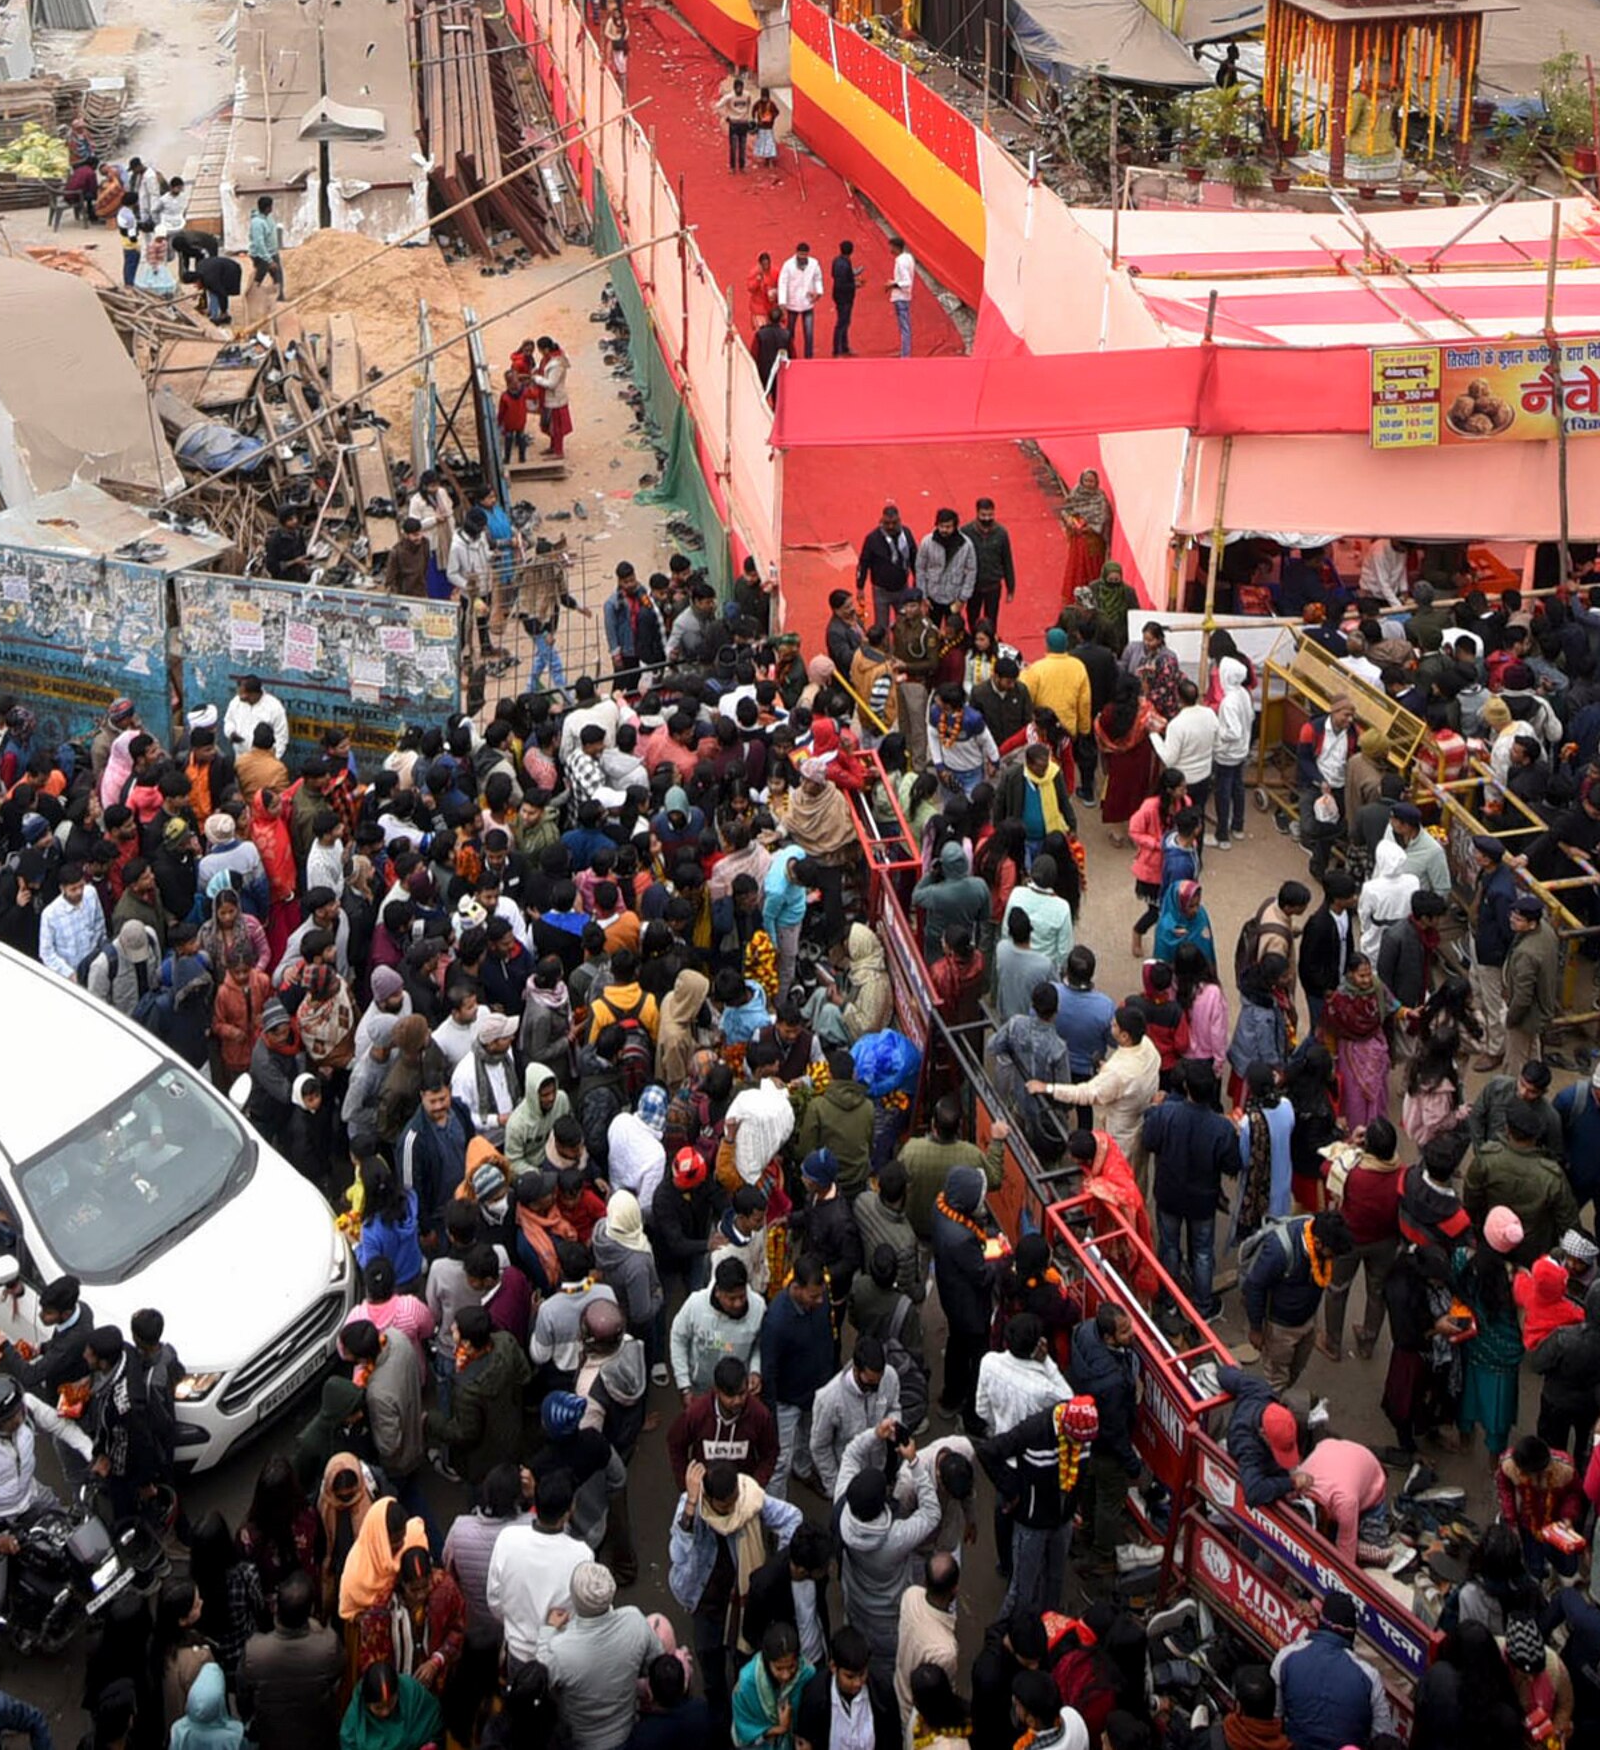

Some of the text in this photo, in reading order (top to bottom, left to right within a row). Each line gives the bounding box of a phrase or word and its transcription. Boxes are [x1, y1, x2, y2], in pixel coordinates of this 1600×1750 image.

[1447, 348, 1481, 369] तिरुपति
[296, 699, 391, 722] CITY PROJECT
[1378, 1618, 1421, 1664] पटना
